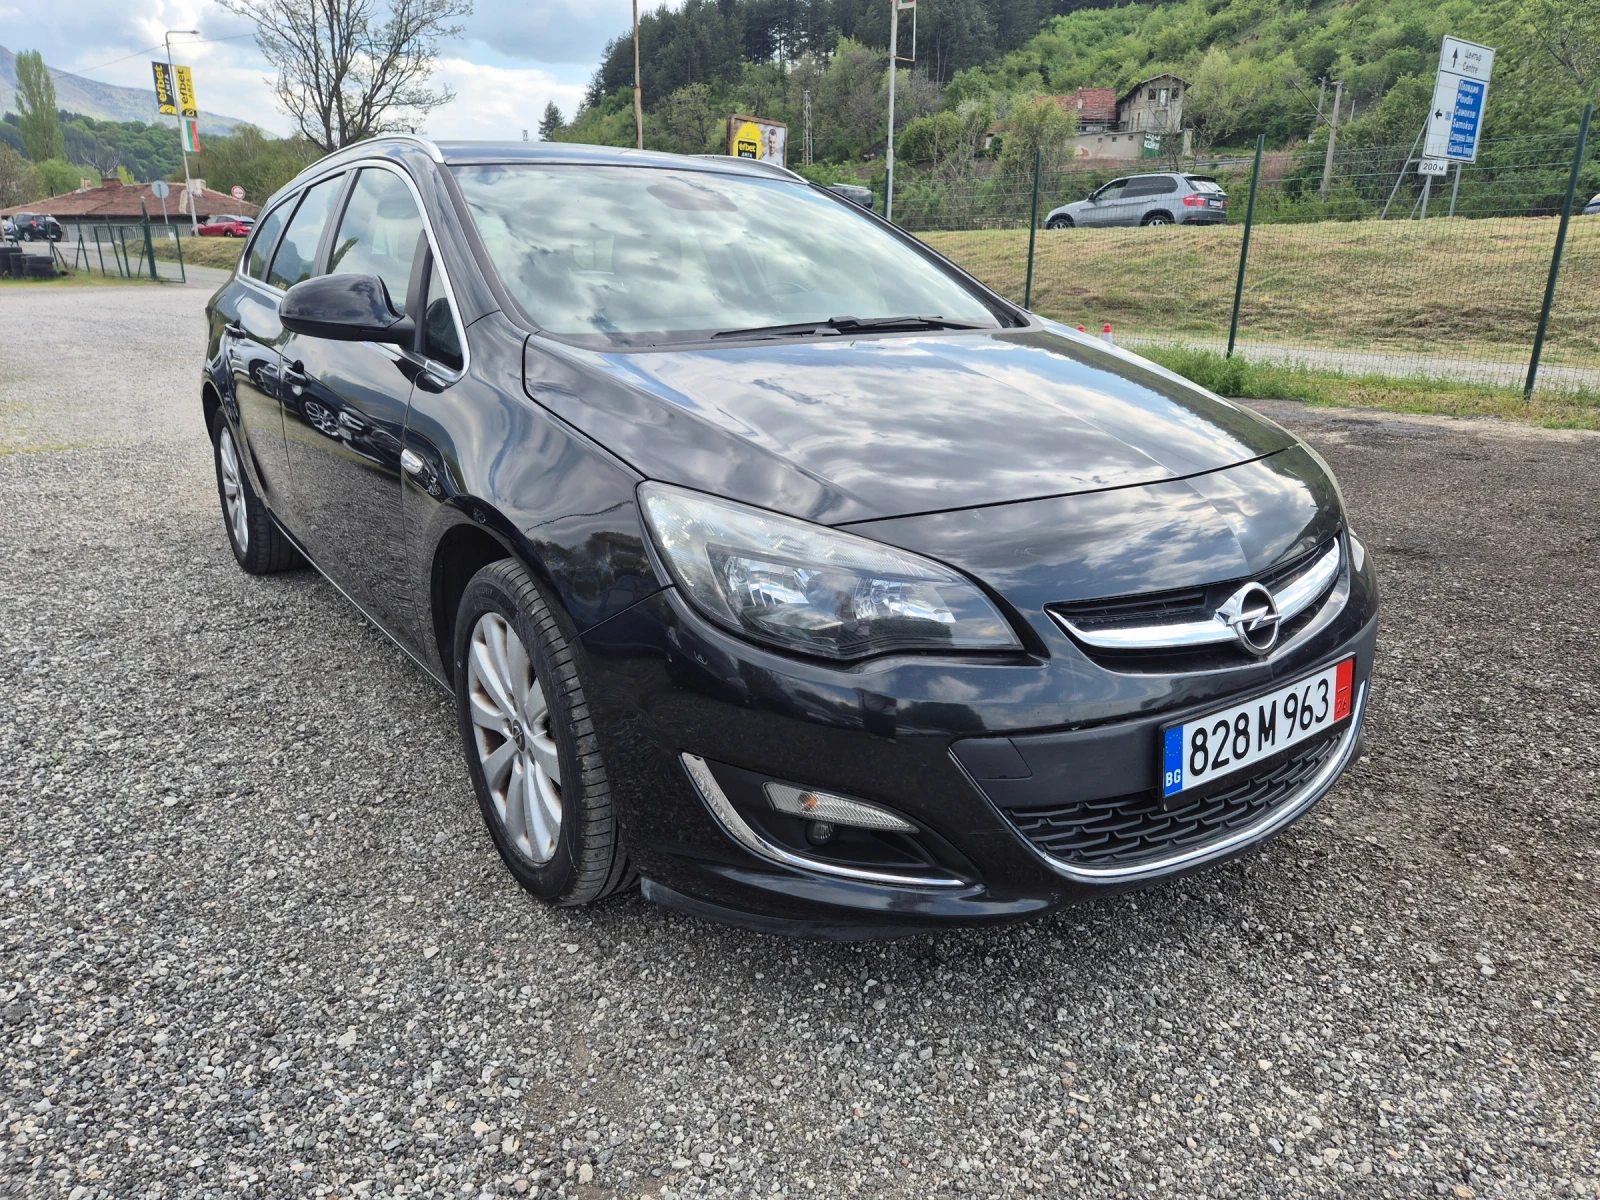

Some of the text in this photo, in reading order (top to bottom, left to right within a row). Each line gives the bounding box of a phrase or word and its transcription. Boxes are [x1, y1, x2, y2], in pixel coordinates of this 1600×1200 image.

[1462, 61, 1478, 74] Centre
[154, 64, 168, 103] efbet
[178, 68, 189, 104] efbet
[1456, 93, 1475, 105] Plovdiv
[1452, 118, 1474, 131] Samokov
[1423, 162, 1438, 171] 200
[1189, 678, 1329, 777] 828 M 963
[1165, 768, 1182, 788] BG
